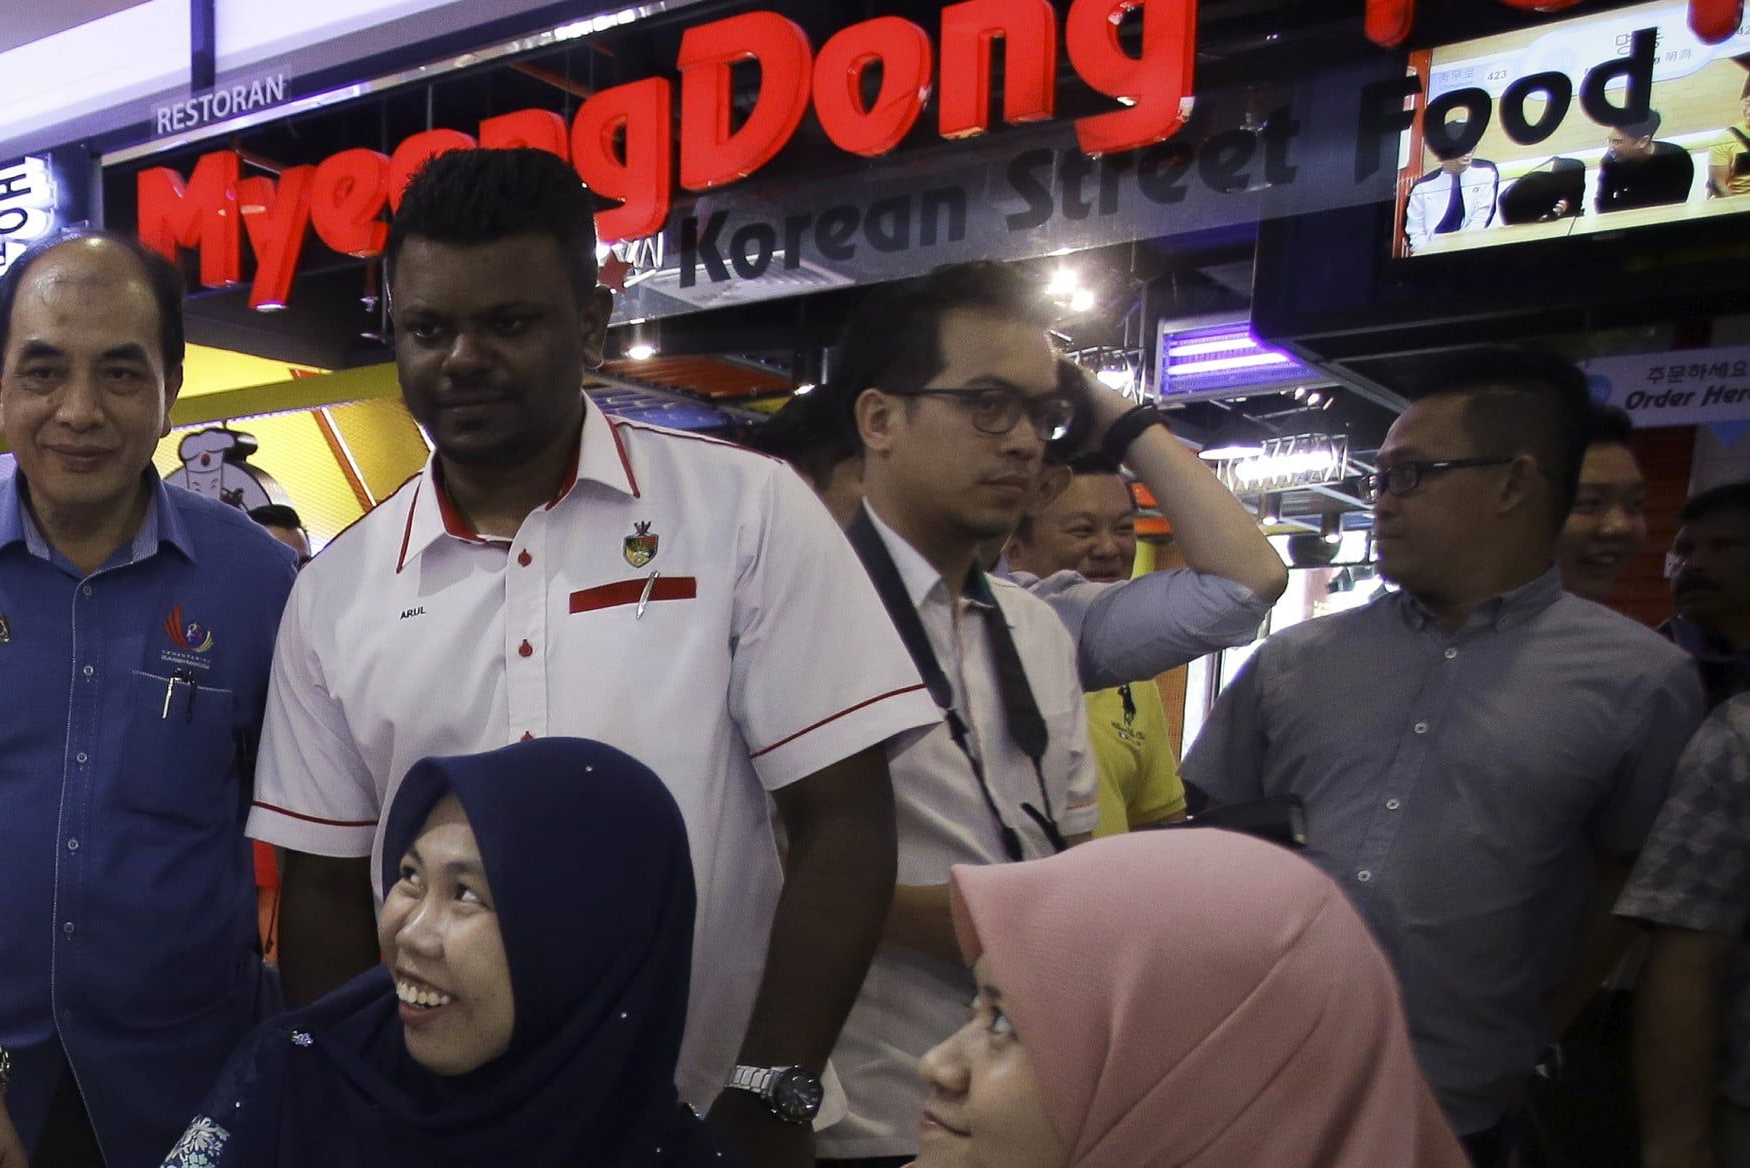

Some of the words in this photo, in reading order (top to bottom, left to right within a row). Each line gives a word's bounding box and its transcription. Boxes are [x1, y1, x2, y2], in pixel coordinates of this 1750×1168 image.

[1486, 69, 1507, 81] 423
[156, 73, 285, 135] RESTORAN
[679, 182, 967, 289] Korean
[1005, 103, 1301, 232] Street
[1353, 26, 1658, 186] Food
[1646, 359, 1748, 385] 주문하세요
[1624, 388, 1697, 411] Order
[1700, 385, 1750, 407] Her
[399, 605, 427, 620] ARUL
